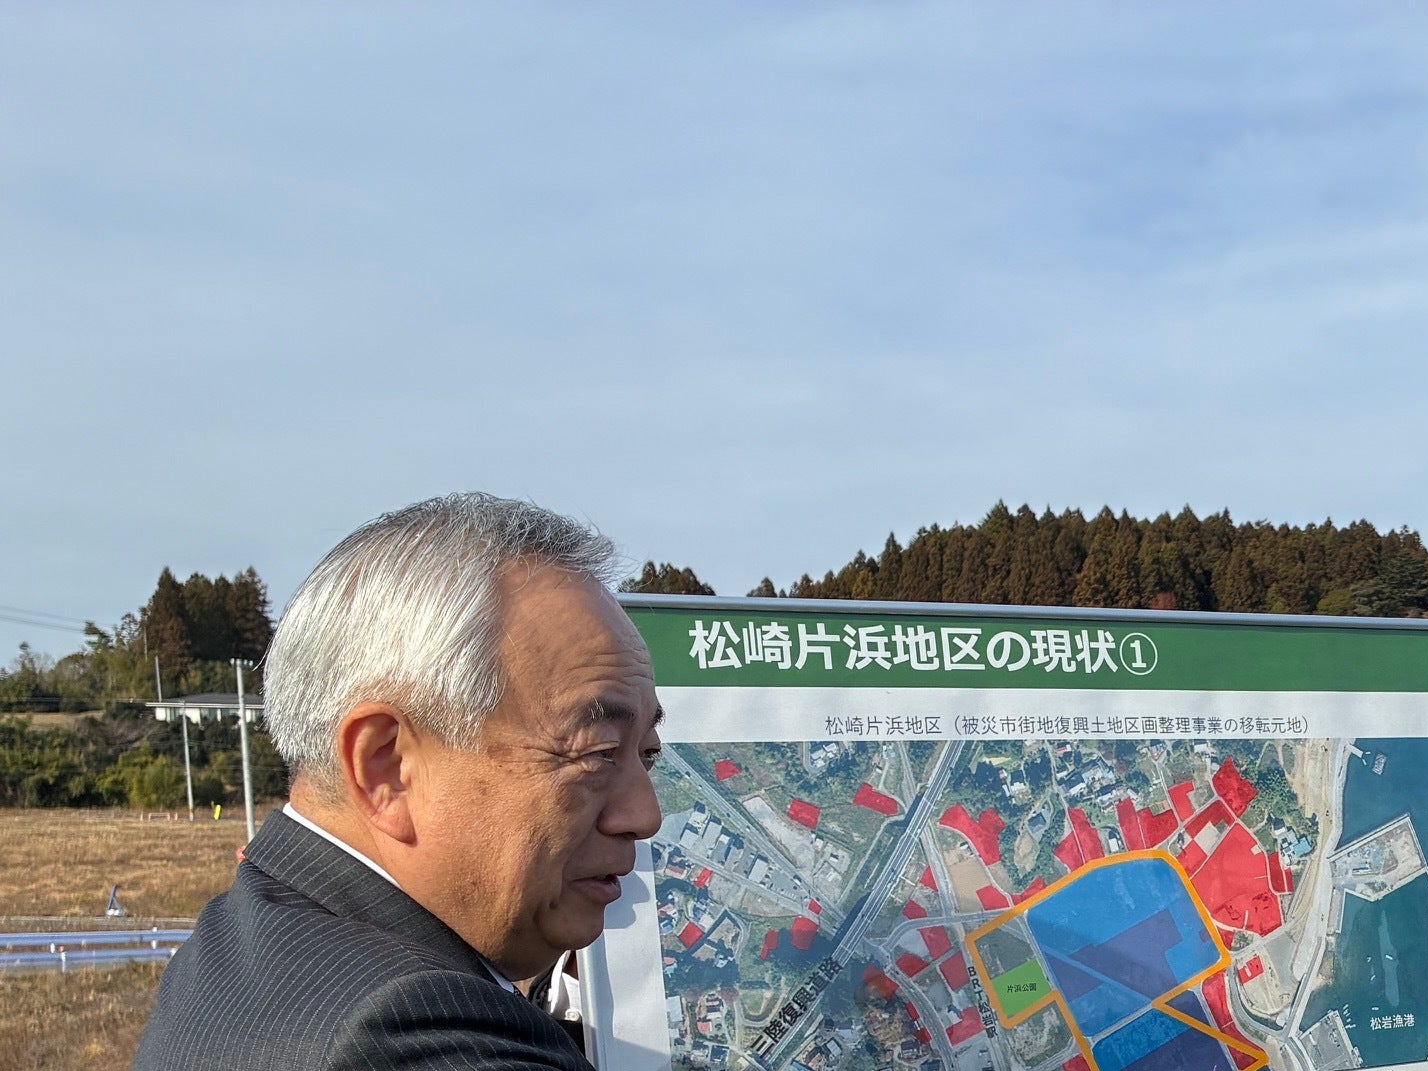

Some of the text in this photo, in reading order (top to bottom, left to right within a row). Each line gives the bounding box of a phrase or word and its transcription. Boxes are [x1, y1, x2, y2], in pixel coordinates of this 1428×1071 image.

[688, 620, 1159, 676] 松崎片浜地区の現状①
[824, 715, 1309, 736] 松崎片浜地区（被災市街地復興土地区画整理事業の移転元地）
[1007, 983, 1037, 993] 片浜公園
[750, 957, 843, 1059] 三陸復興道路
[1370, 1013, 1415, 1031] 松岩漁港
